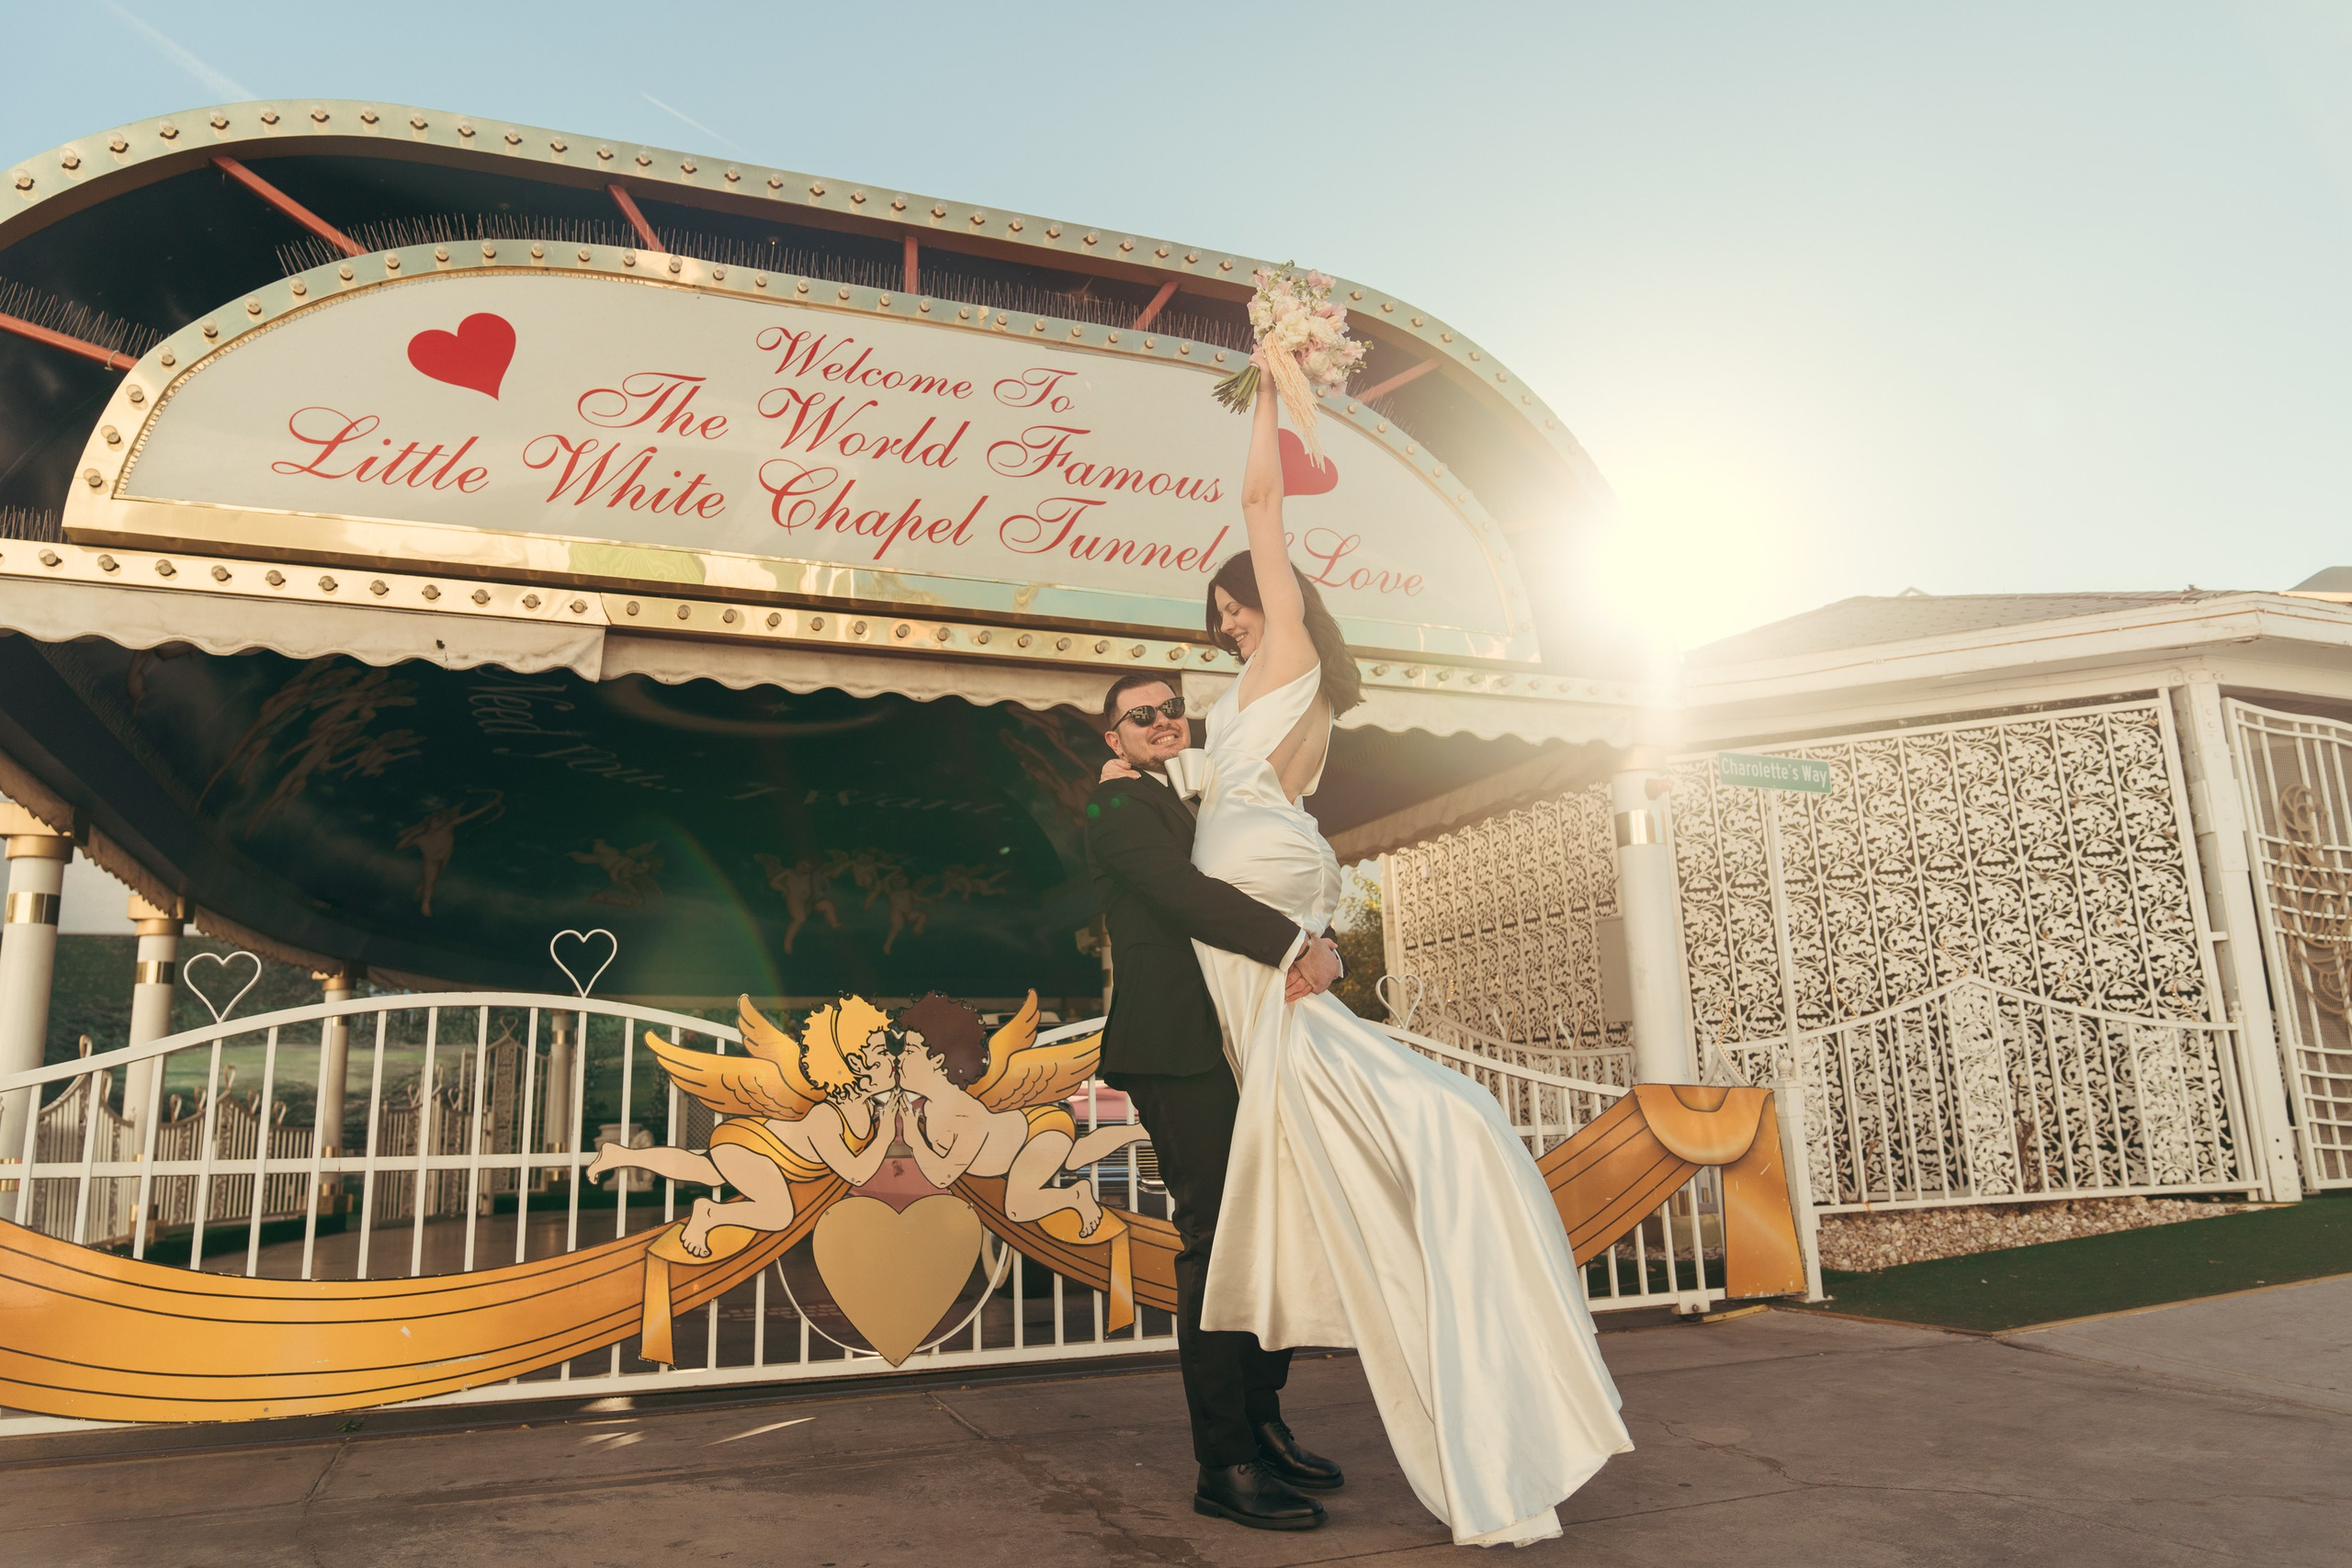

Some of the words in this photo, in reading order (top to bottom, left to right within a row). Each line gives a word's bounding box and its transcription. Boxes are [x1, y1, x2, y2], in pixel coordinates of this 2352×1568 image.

[755, 325, 974, 400] Welcome
[992, 367, 1077, 414] To
[576, 371, 729, 440] The
[757, 387, 972, 469] World
[986, 424, 1225, 504] Famous
[270, 406, 490, 493] Little
[522, 434, 727, 520] White
[757, 457, 989, 561] Chapel
[999, 496, 1230, 574] Tunnel
[1303, 526, 1425, 597] Love
[1721, 757, 1799, 781] Charolette's
[1801, 764, 1827, 788] Way
